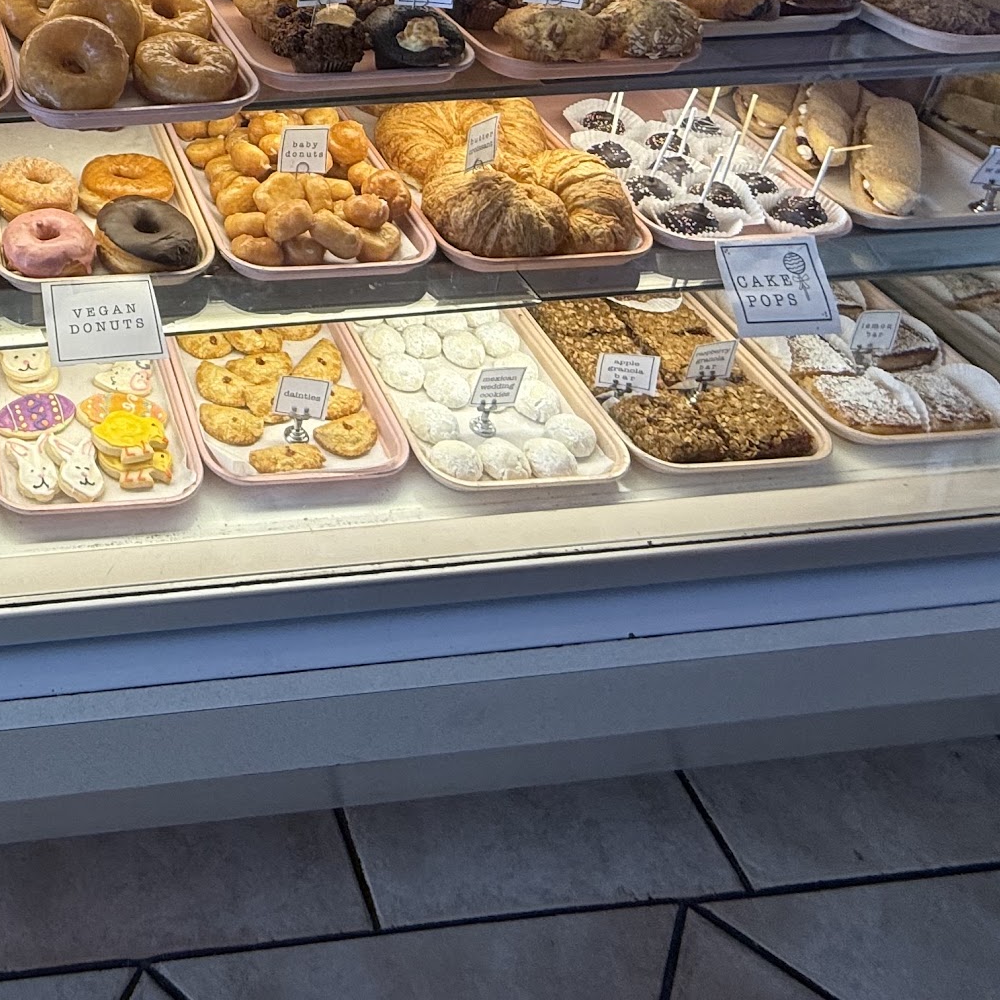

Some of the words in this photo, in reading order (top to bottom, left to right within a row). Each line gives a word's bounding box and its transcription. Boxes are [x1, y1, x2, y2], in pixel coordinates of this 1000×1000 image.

[292, 141, 318, 150] baby
[736, 274, 793, 288] CAKE
[745, 293, 798, 307] POPS
[72, 303, 136, 318] VEGAN
[69, 318, 144, 334] DONUTS
[614, 359, 640, 367] apple
[607, 366, 645, 375] granola
[614, 373, 635, 382] bar
[284, 390, 321, 402] dainties
